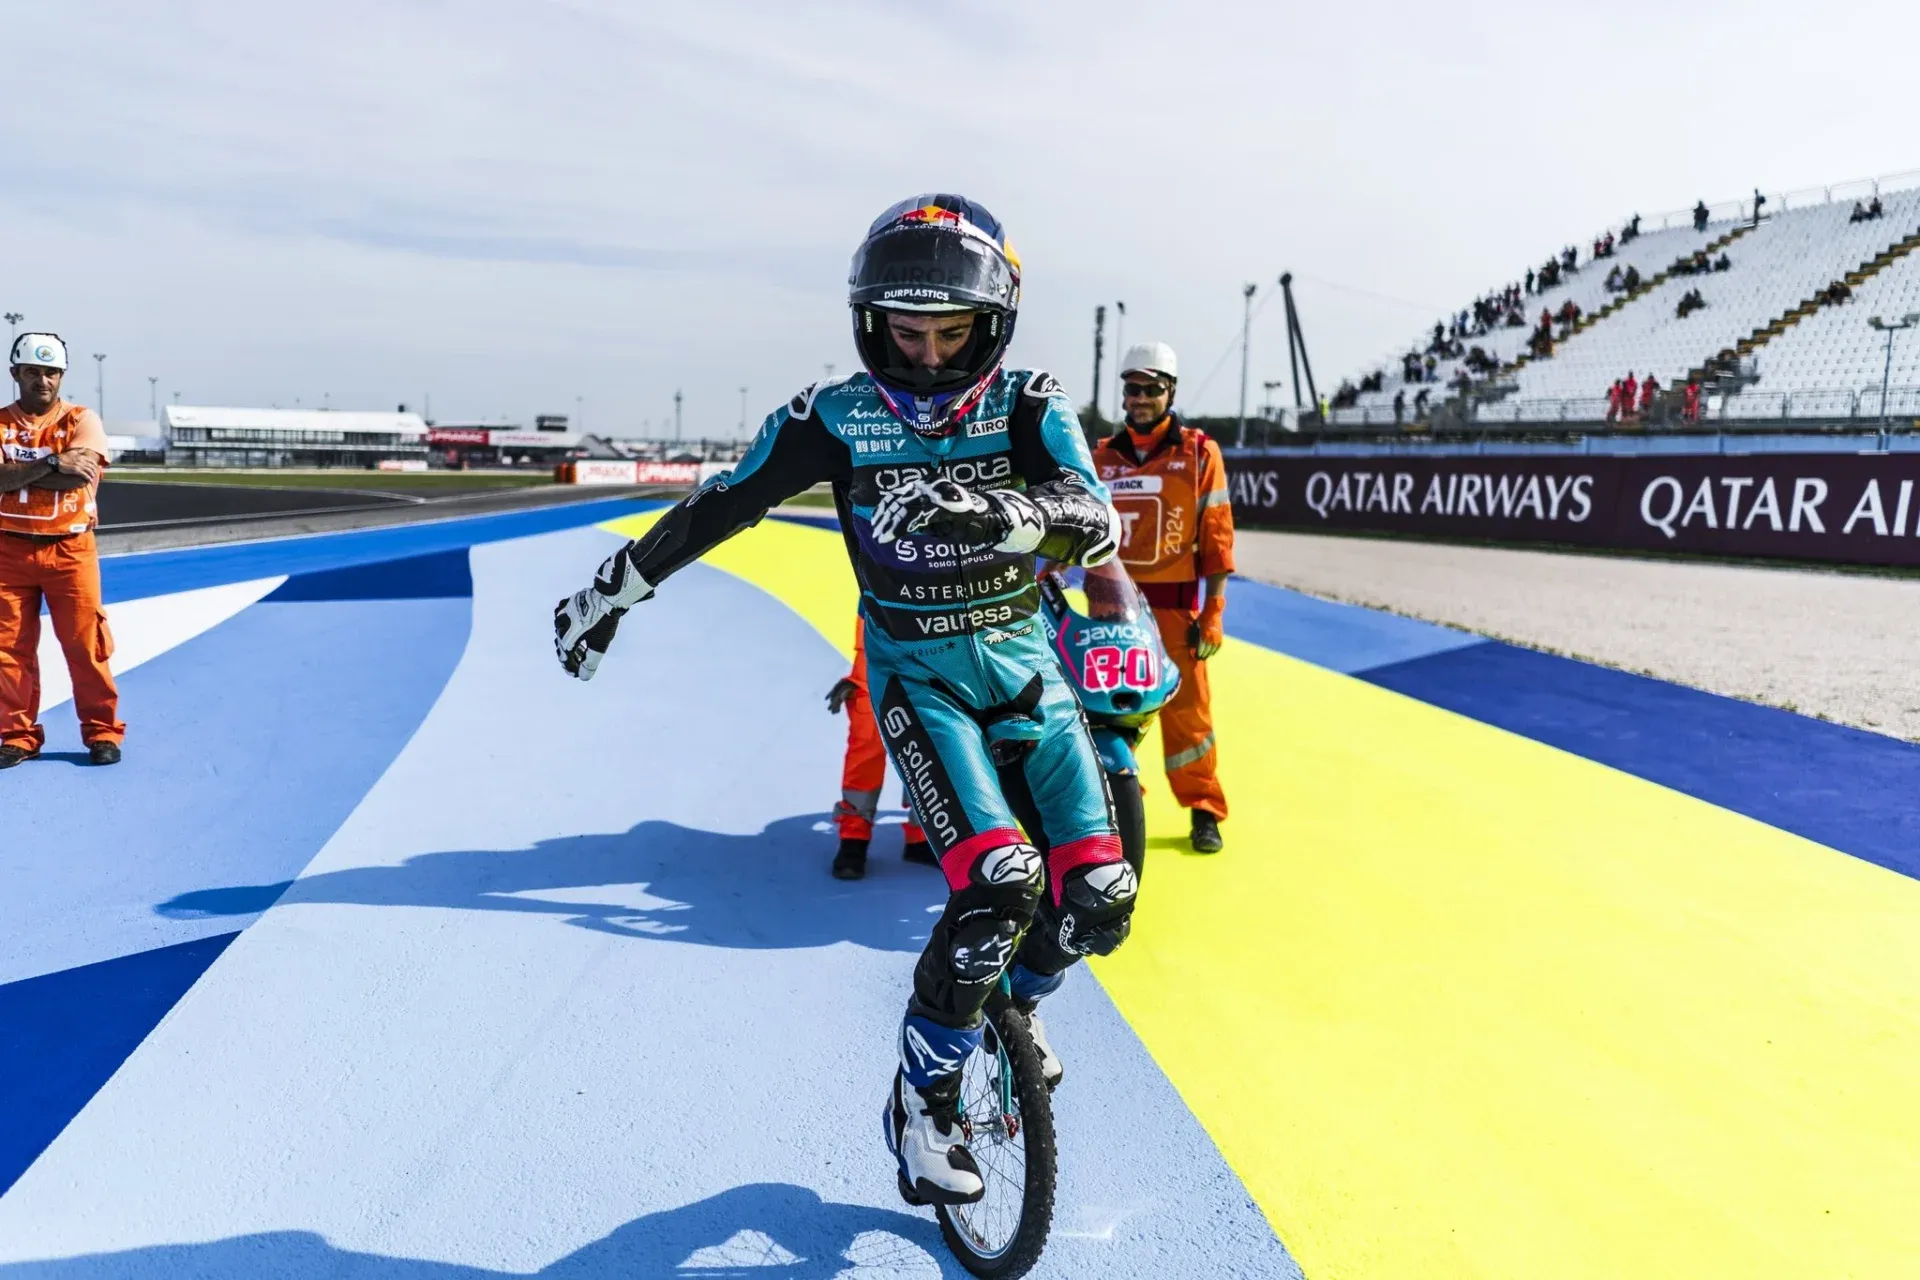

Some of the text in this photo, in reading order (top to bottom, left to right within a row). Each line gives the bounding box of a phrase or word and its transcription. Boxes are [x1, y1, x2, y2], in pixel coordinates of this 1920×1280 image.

[884, 288, 949, 301] DURPLASTICS
[864, 311, 873, 333] AIROH
[837, 422, 903, 436] valresa
[1112, 479, 1144, 490] TRACK
[1305, 471, 1594, 522] QATAR AIRWAYS
[63, 492, 79, 513] 20
[1640, 476, 1920, 539] QATAR AI
[1164, 505, 1185, 555] 2024
[924, 543, 971, 559] solu
[928, 553, 994, 569] SOMOS IMPULSO
[915, 605, 1013, 635] valresa
[1083, 645, 1158, 694] 80
[896, 753, 927, 823] SOMOS IMPULSO
[903, 740, 958, 847] solunion
